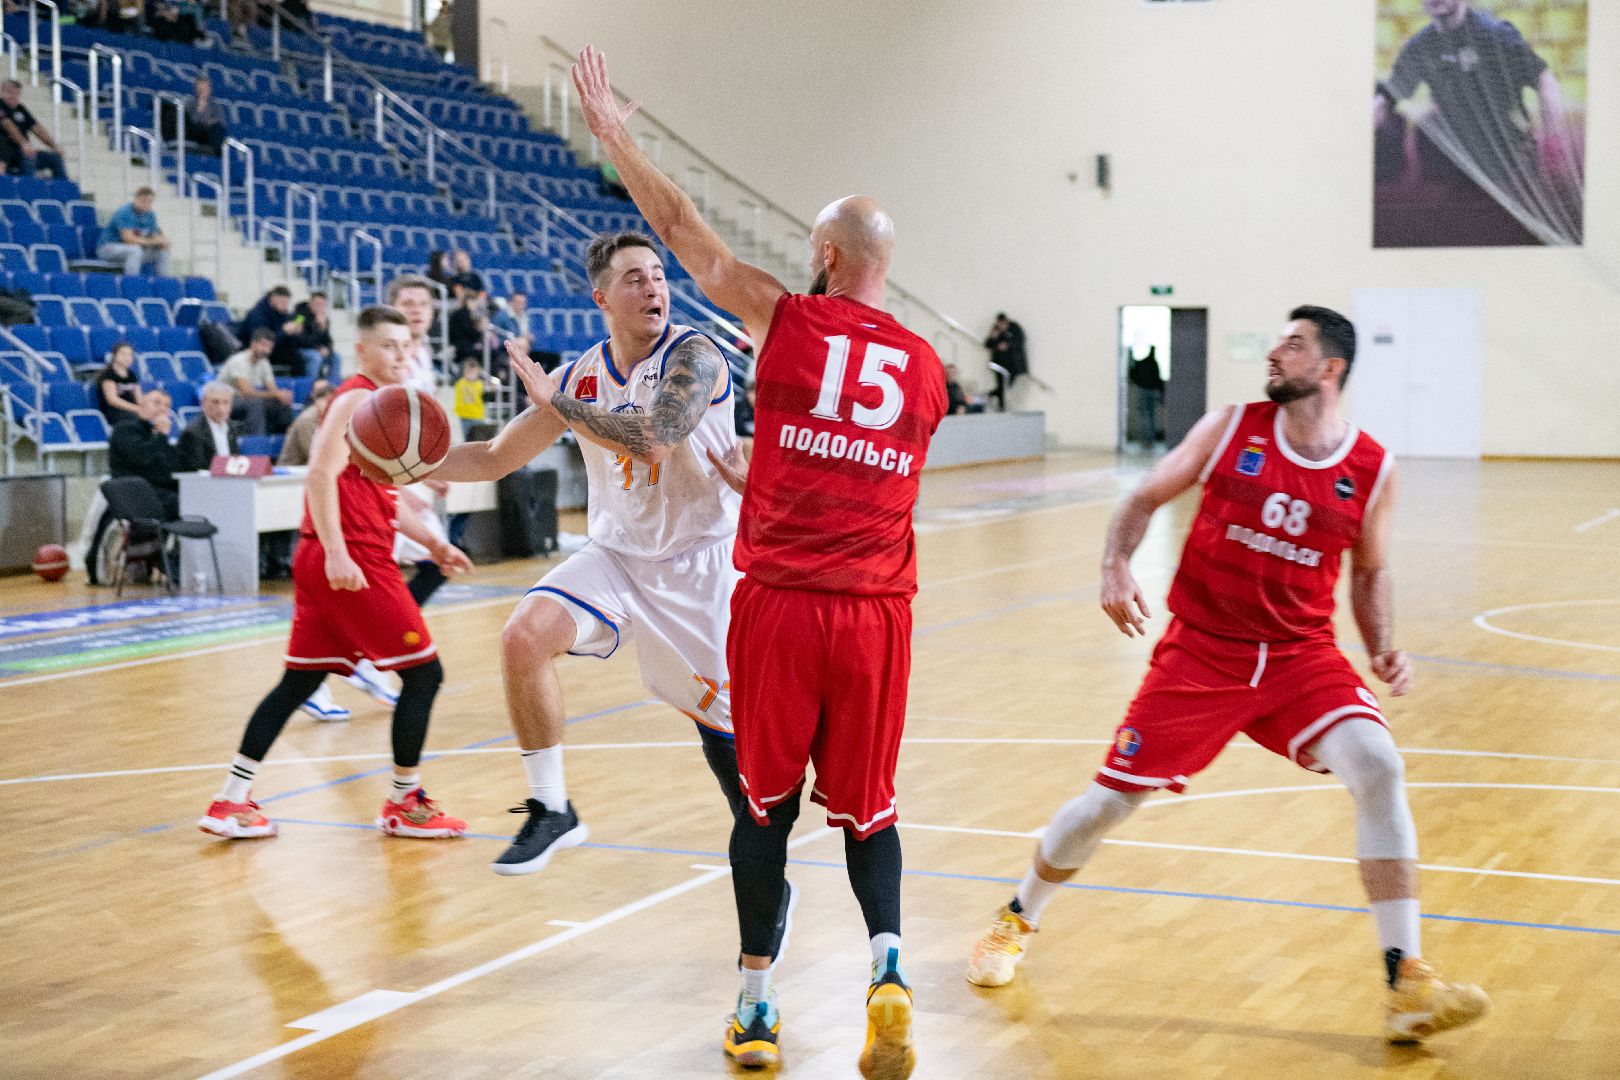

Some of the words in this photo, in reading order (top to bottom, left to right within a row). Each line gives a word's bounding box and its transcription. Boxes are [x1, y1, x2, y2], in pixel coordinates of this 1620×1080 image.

[809, 335, 910, 431] 15
[779, 424, 914, 477] ПОДОЛЬСК
[1261, 492, 1312, 537] 68
